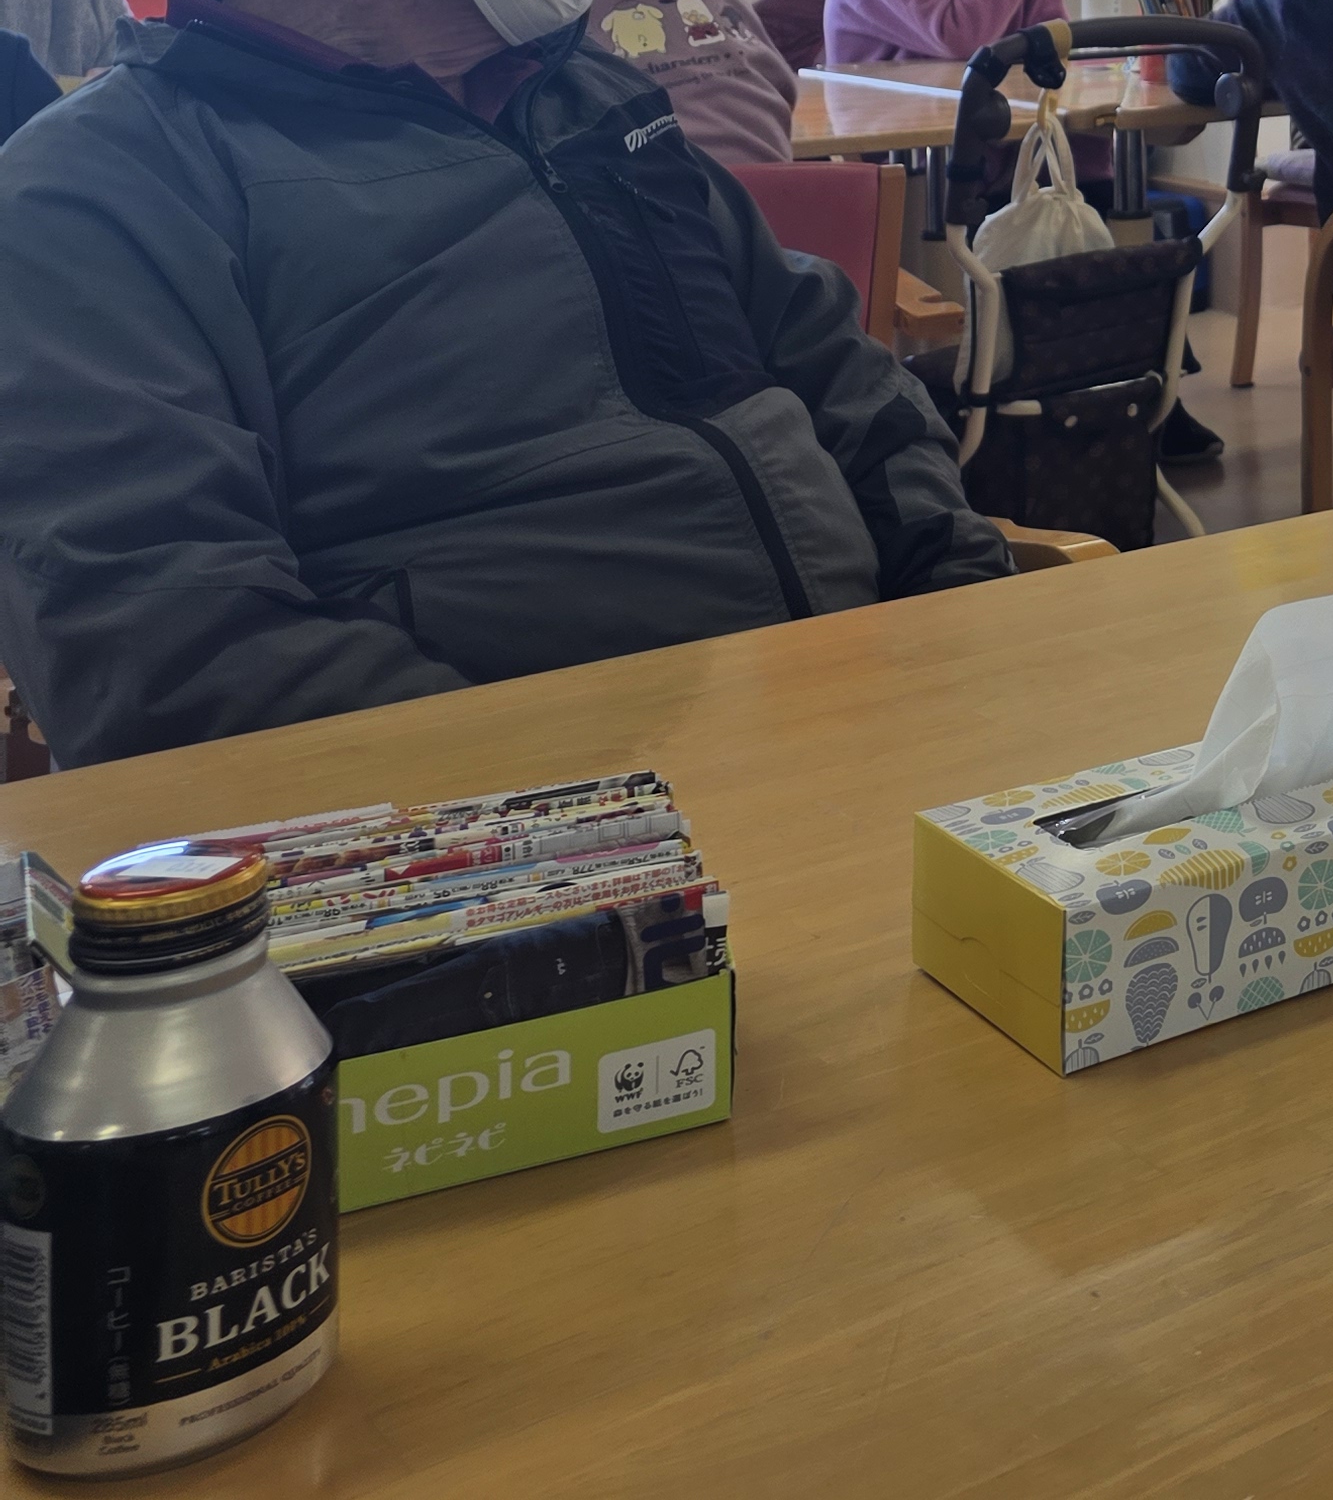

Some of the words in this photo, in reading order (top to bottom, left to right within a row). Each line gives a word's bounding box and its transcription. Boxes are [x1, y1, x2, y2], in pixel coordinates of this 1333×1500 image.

[614, 1088, 644, 1104] WWF
[675, 1073, 705, 1089] FSC
[189, 1227, 318, 1302] BARISTA'S
[155, 1241, 331, 1364] BLACK
